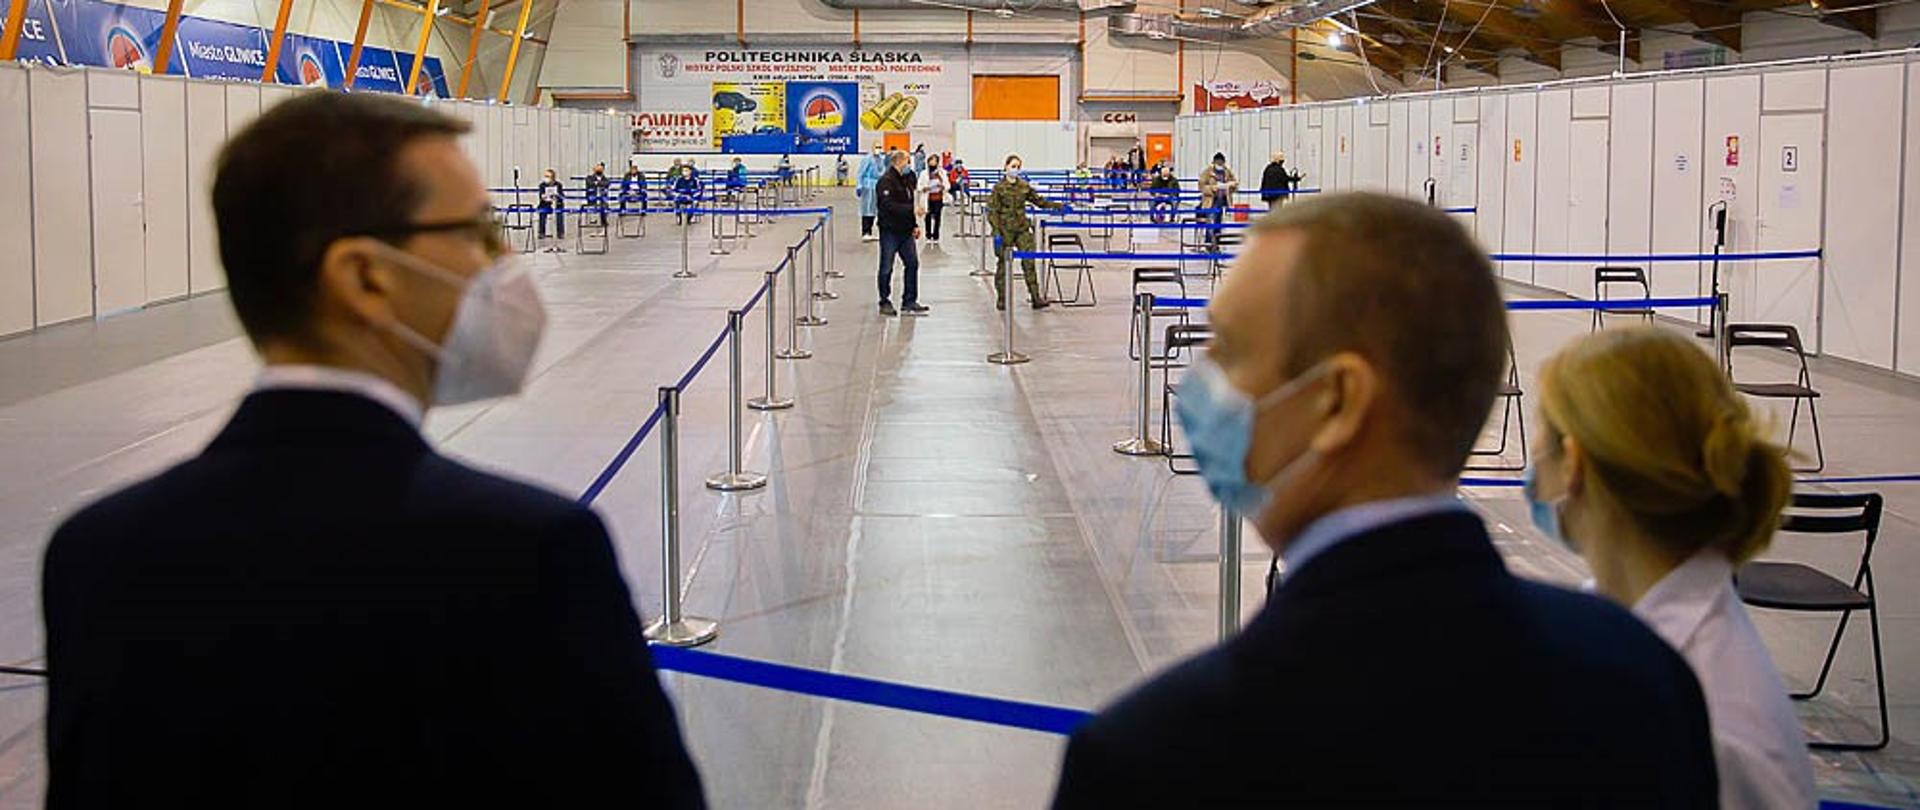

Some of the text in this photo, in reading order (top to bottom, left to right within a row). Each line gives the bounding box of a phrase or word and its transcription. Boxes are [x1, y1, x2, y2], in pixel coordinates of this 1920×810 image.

[705, 51, 844, 62] POLITECHNIKA
[716, 64, 743, 72] POLSKI
[860, 64, 887, 72] POLSKI
[1103, 113, 1136, 124] CCM
[1786, 151, 1793, 166] 2
